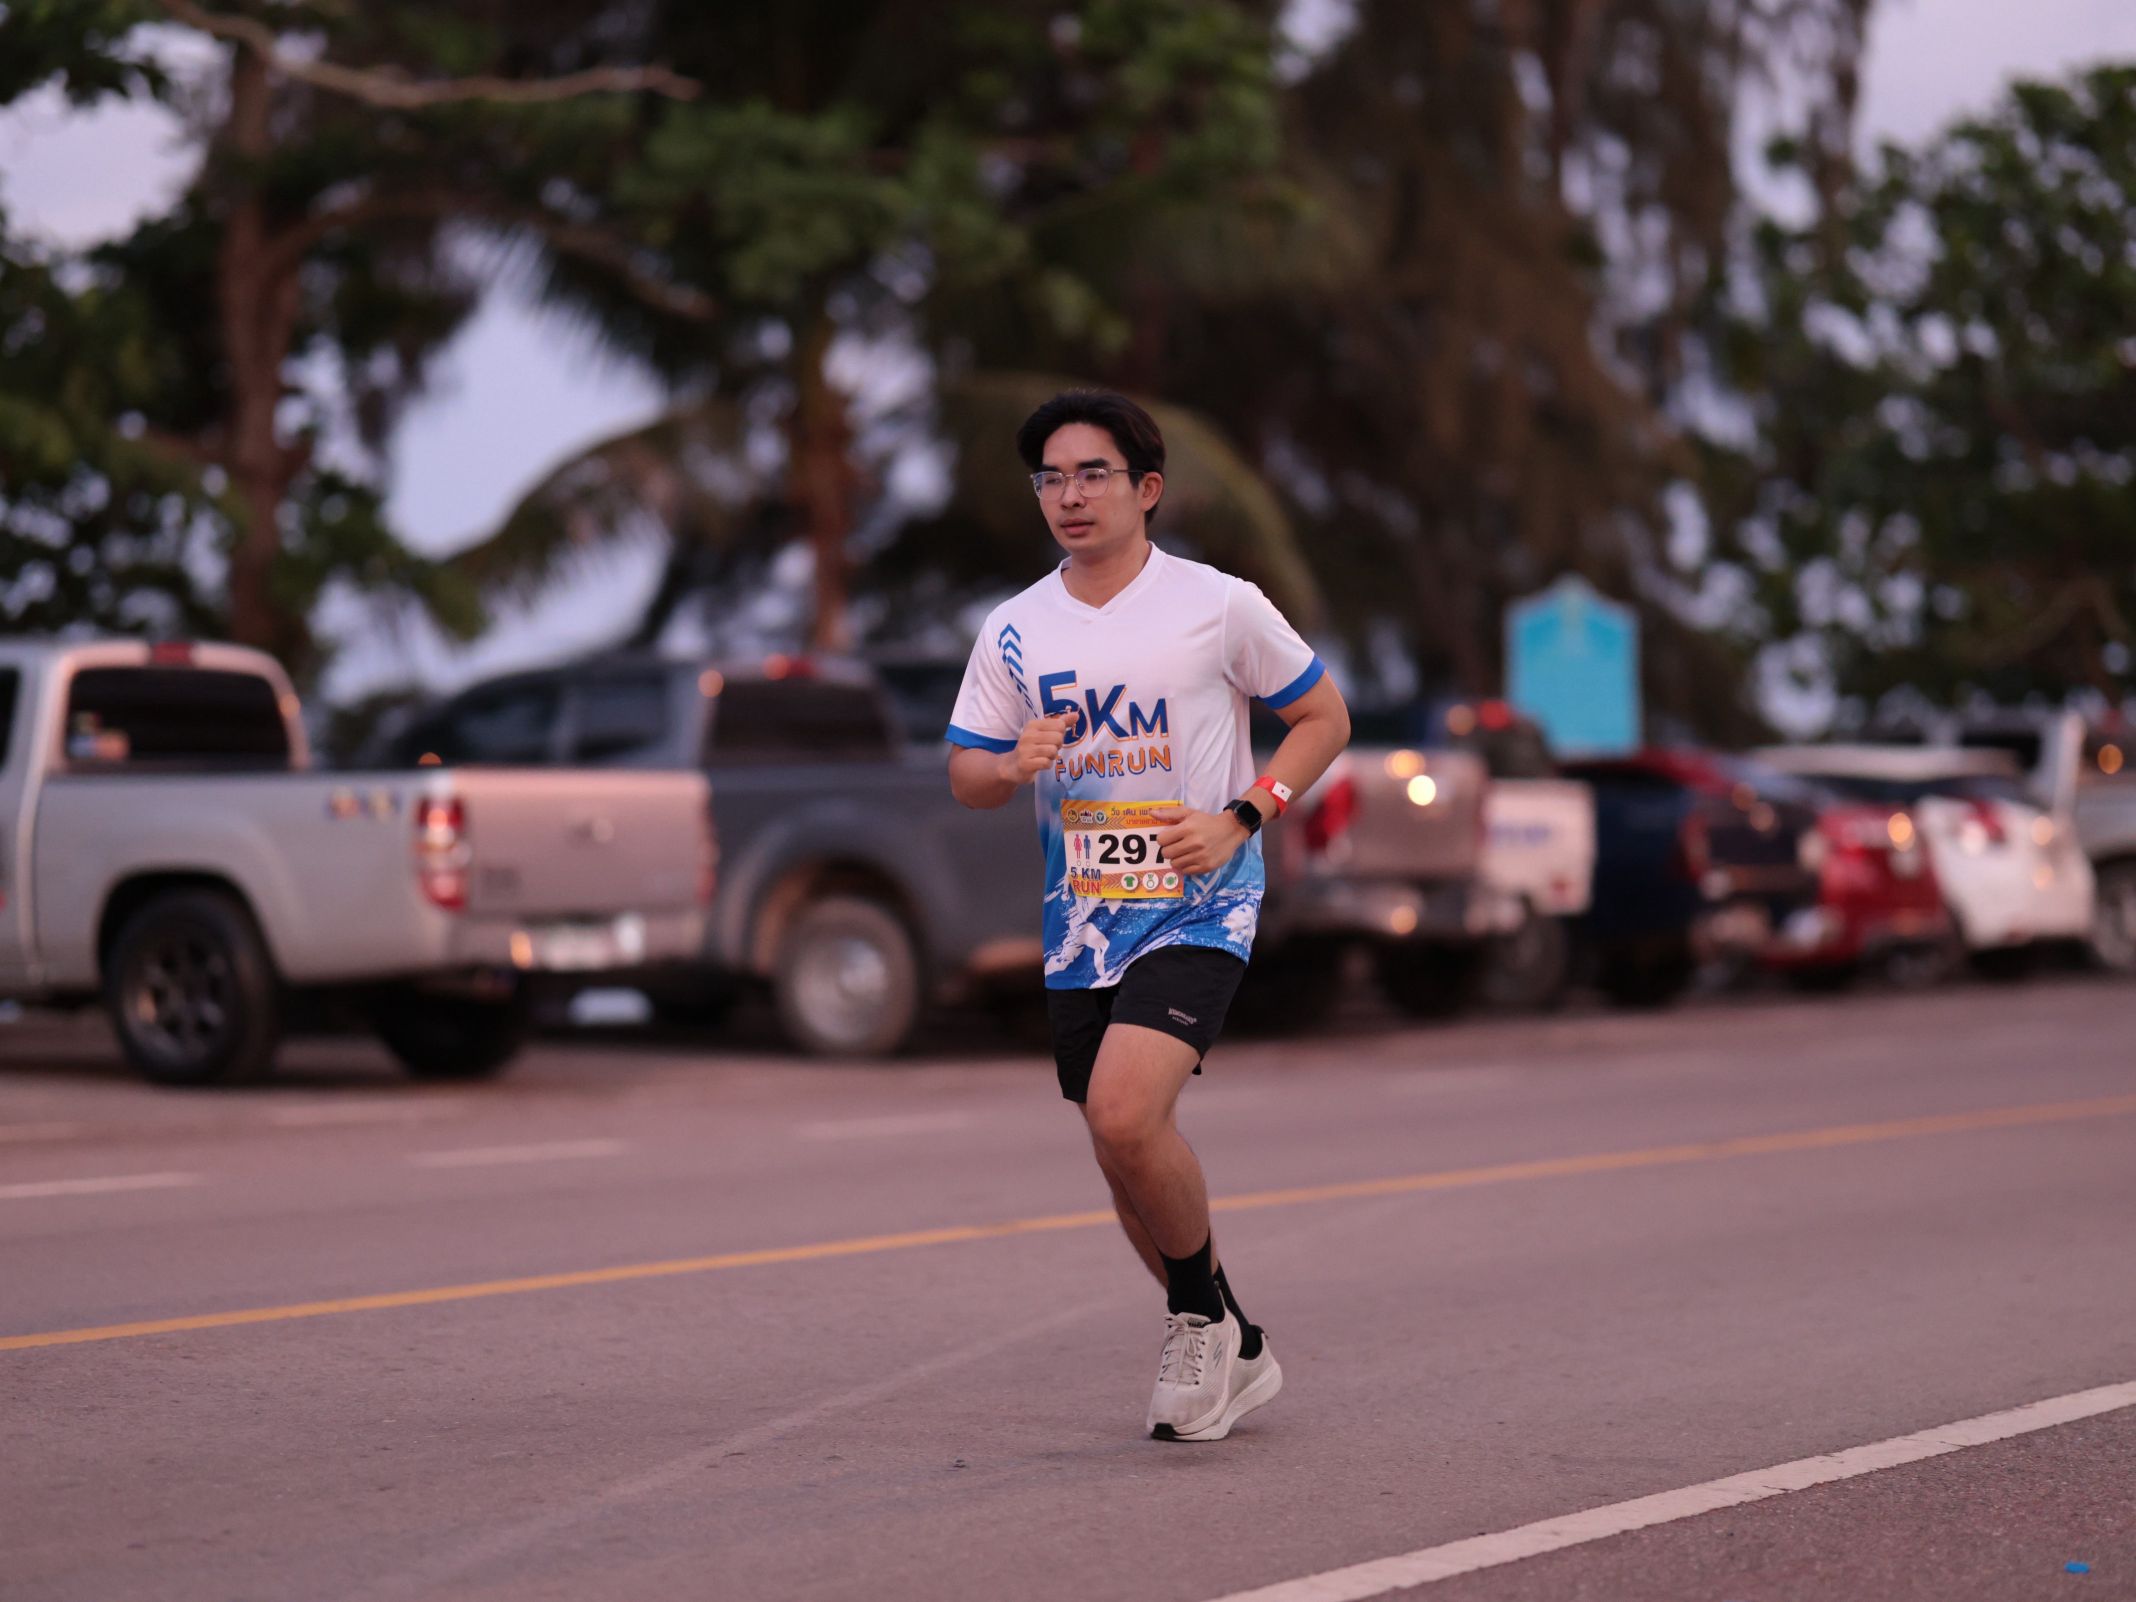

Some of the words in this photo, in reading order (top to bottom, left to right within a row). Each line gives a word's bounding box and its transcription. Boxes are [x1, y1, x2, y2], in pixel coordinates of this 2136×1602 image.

[1055, 745, 1172, 782] FUNRUN
[1071, 866, 1078, 879] 5
[1081, 867, 1102, 880] KM
[1072, 880, 1101, 895] RUN
